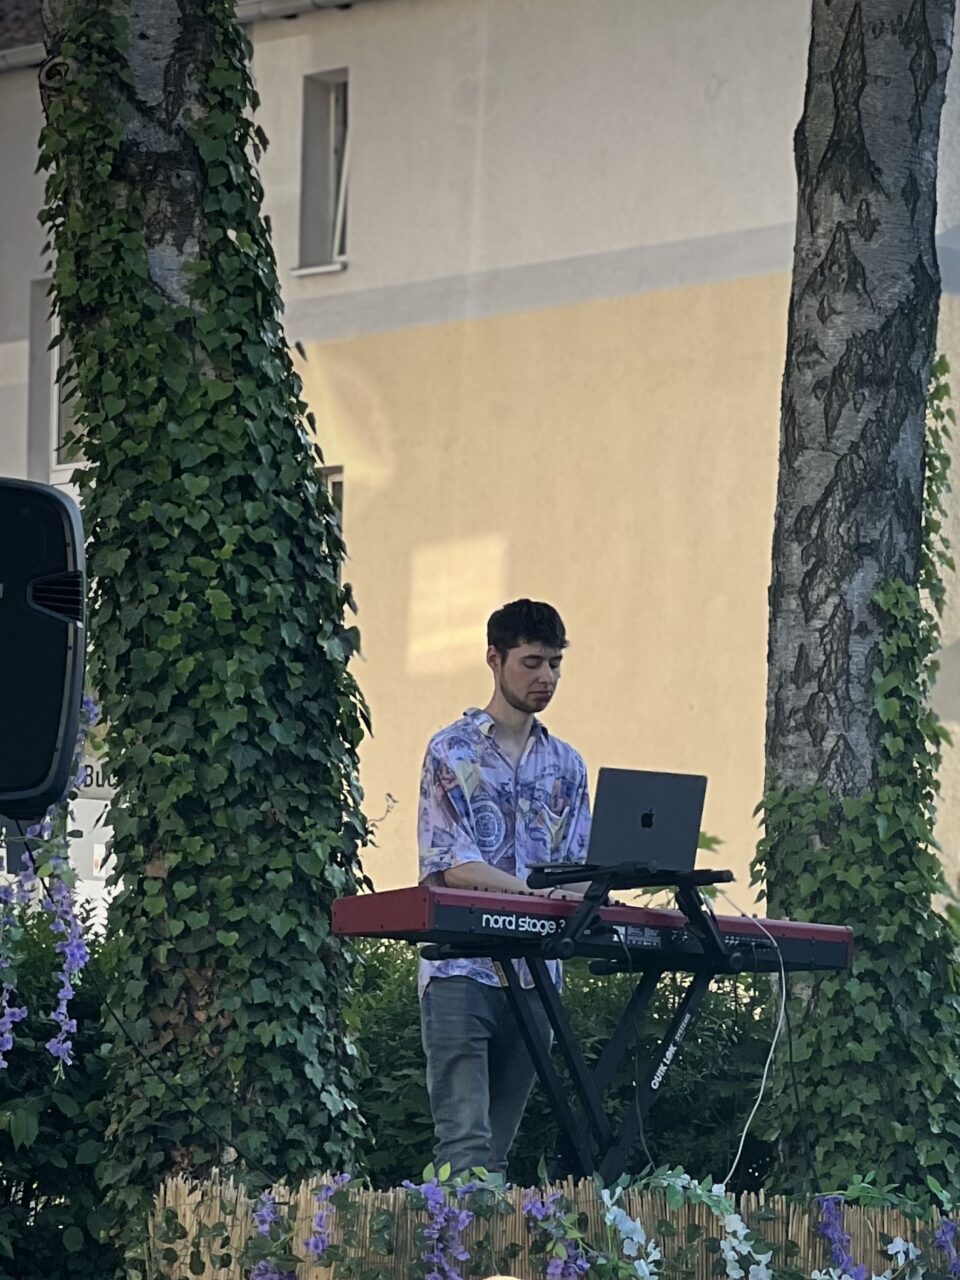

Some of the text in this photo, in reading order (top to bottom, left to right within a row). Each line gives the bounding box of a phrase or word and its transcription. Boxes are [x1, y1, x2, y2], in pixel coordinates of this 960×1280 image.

[482, 914, 516, 930] nord
[518, 916, 556, 936] stage
[651, 1063, 668, 1090] QUIK
[663, 1043, 678, 1065] LOK
